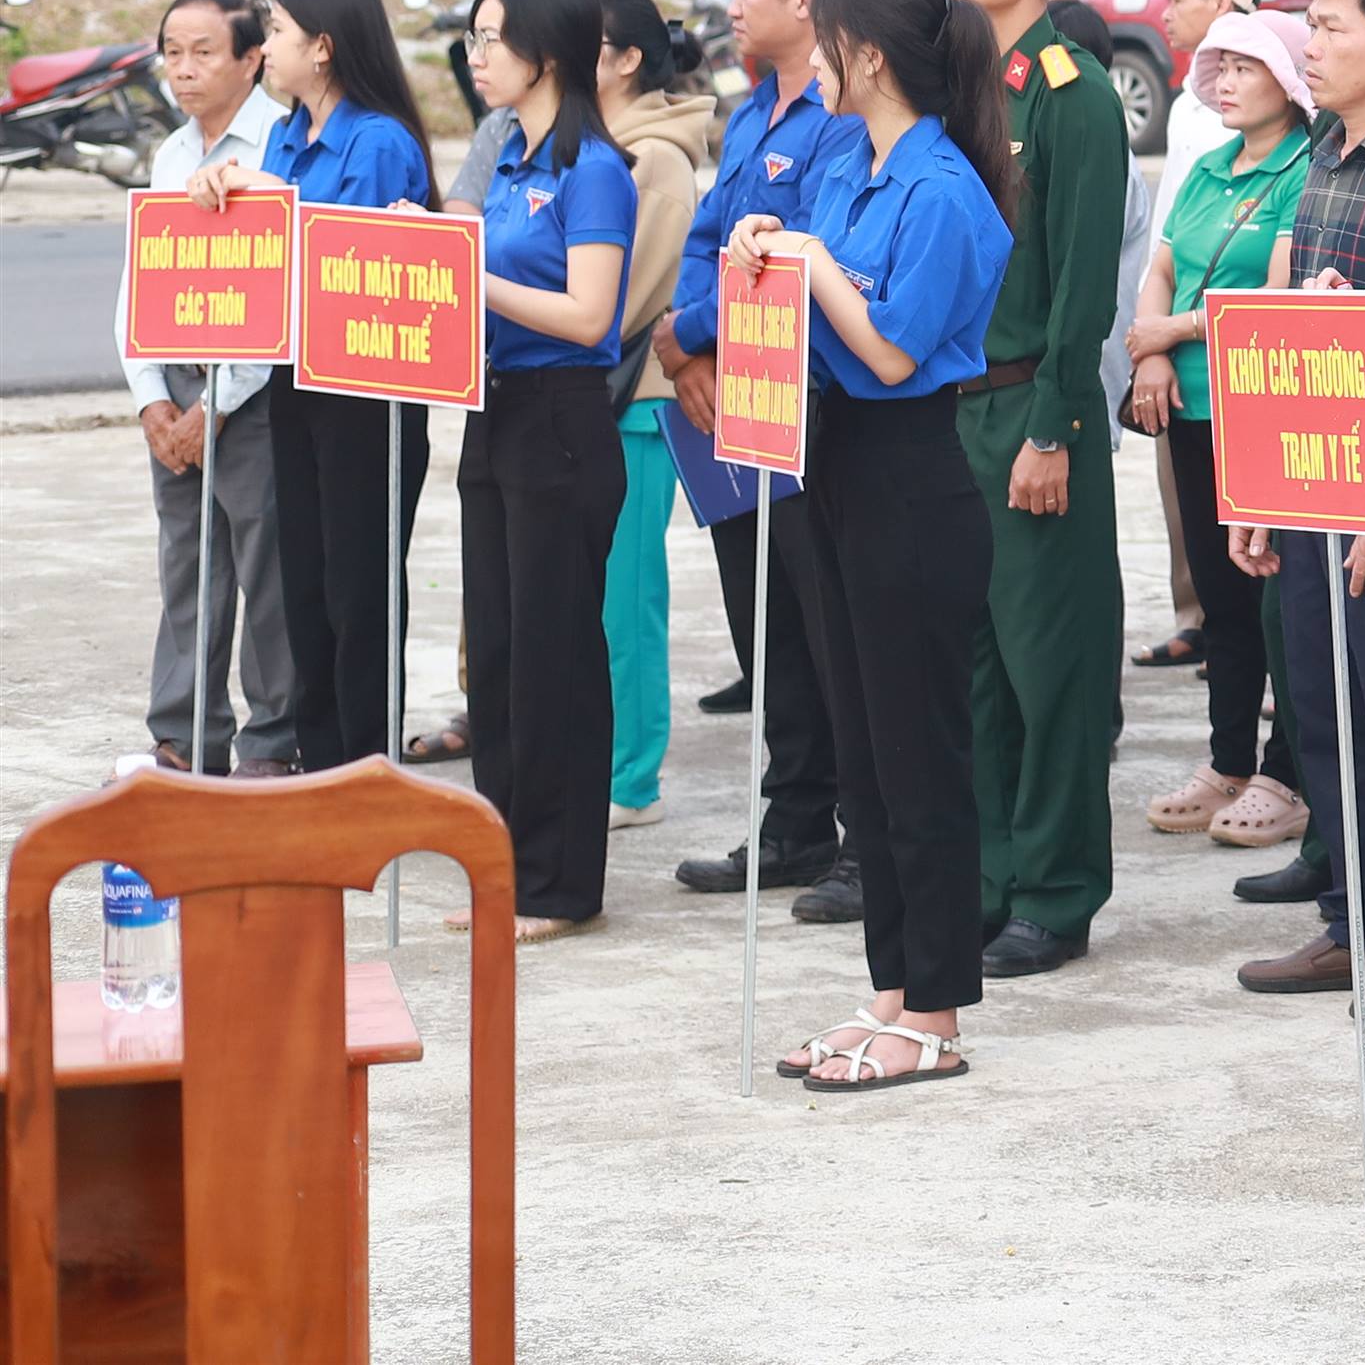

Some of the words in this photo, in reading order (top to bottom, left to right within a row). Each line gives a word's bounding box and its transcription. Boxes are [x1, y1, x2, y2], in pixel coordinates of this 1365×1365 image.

[140, 224, 174, 270] KHỐI
[176, 235, 207, 270] BAN
[210, 228, 251, 269] NHÂN
[253, 228, 284, 269] DÂN
[175, 285, 204, 326] CÁC
[207, 285, 246, 326] THÔN
[320, 246, 361, 295] KHỐI
[365, 254, 403, 306] MẶT
[406, 258, 459, 310] TRẬN,
[345, 314, 394, 360] ĐOÀN
[398, 313, 433, 364] THỂ
[1227, 331, 1266, 395] KHỐI
[1268, 338, 1300, 396] CÁC
[1301, 338, 1365, 399] TRƯỜNG
[1280, 432, 1326, 491] TRẠM
[1327, 434, 1338, 482] Y
[1341, 419, 1363, 483] TẾ
